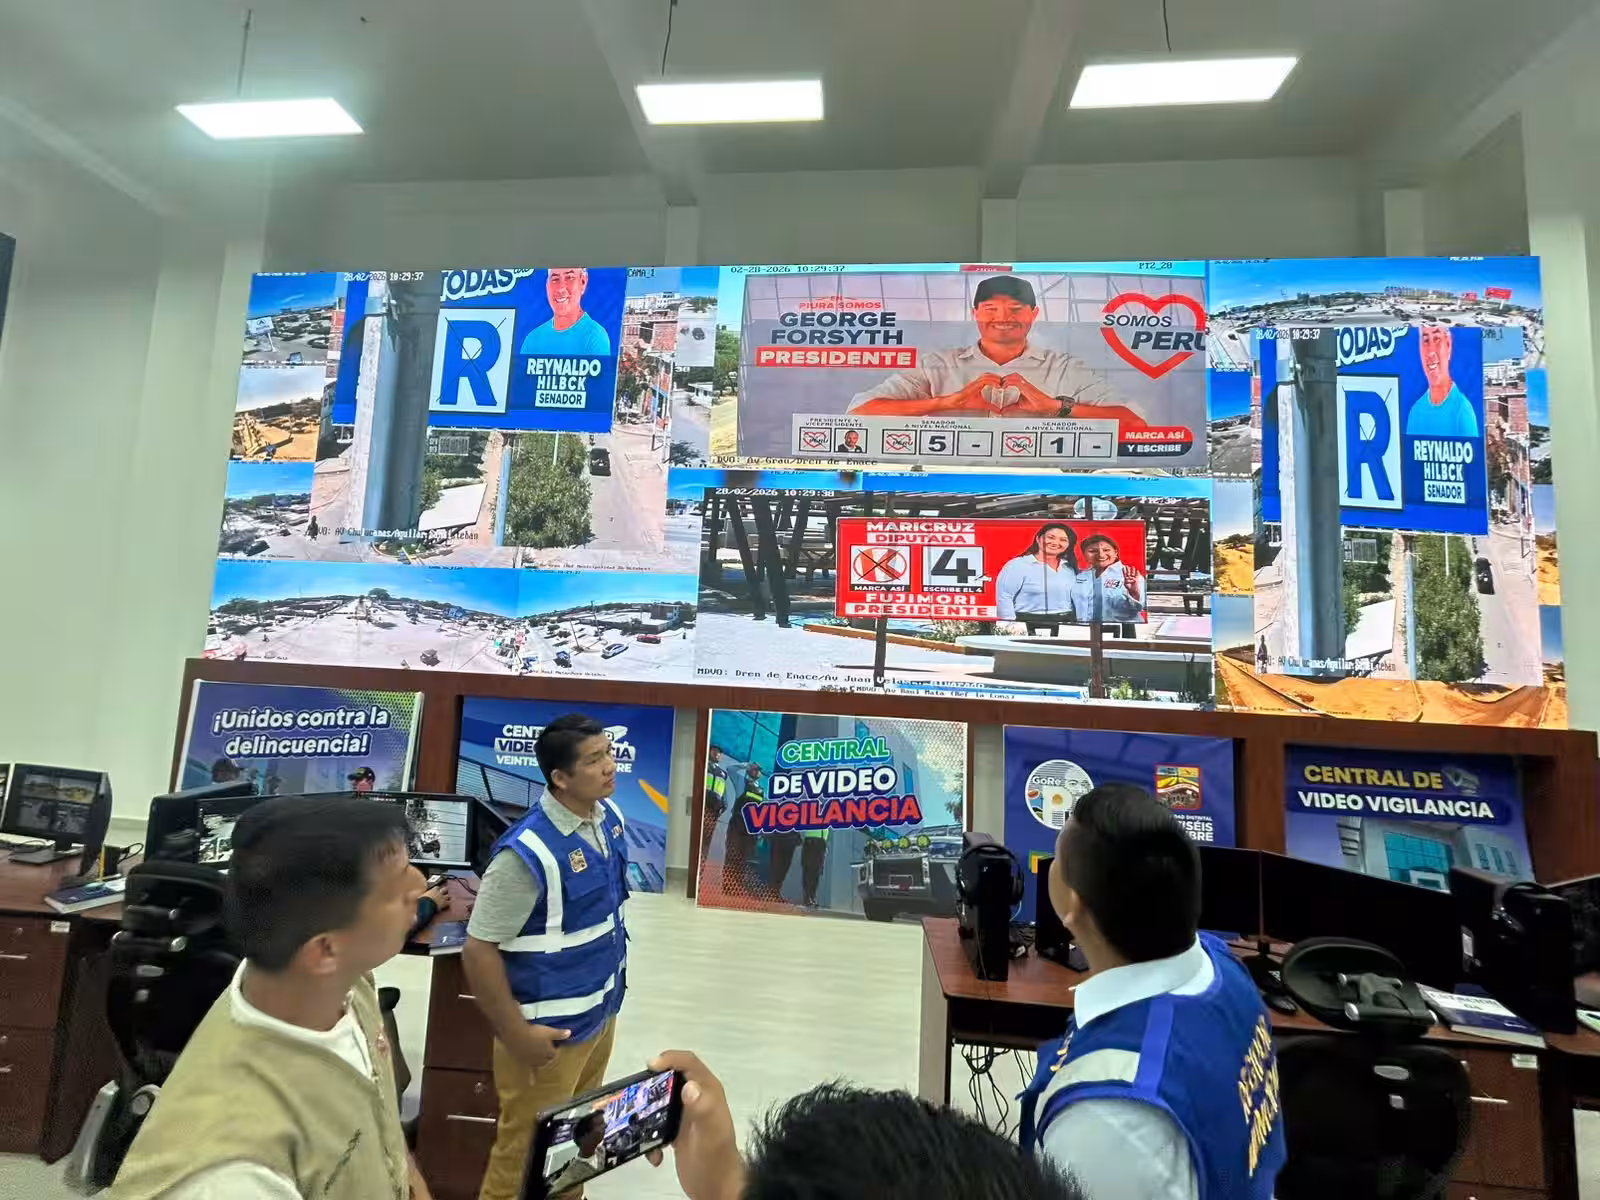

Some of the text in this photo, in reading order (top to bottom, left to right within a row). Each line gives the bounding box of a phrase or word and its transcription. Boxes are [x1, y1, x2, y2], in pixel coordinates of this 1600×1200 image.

[390, 271, 424, 280] 10:29:37
[779, 312, 897, 327] GEORGE
[1102, 314, 1172, 328] SOMOS
[771, 329, 903, 345] FORSYTH
[1292, 329, 1320, 340] 10:29:37
[438, 320, 502, 406] R
[760, 350, 911, 365] PRESIDENTE
[526, 358, 601, 376] REYNALDO
[536, 376, 586, 391] HILBCK
[538, 393, 583, 406] SENADOR
[1167, 430, 1184, 439] ASÍ
[928, 435, 946, 452] 5
[1050, 437, 1064, 454] 1
[1127, 444, 1182, 452] Y ESCRIBE
[1344, 390, 1394, 500] R
[1414, 440, 1473, 463] REYNALDO
[1424, 462, 1464, 481] HILBCK
[715, 488, 778, 496] 28/02/2026
[1427, 484, 1462, 500] SENADOR
[867, 522, 976, 532] MARICRUZ
[875, 534, 967, 543] DIPUTADA
[930, 549, 976, 584] 4
[866, 594, 976, 605] FUJIMORI
[854, 605, 988, 616] PRESIDENTE
[786, 672, 838, 681] Enace/Av
[844, 675, 871, 683] Juan
[213, 706, 389, 732] ¡Unidos contra la
[226, 734, 368, 755] delincuencia!
[498, 740, 534, 752] VIDE
[782, 738, 890, 762] CENTRAL
[773, 768, 896, 795] DE VIDEO
[1304, 765, 1443, 790] CENTRAL DE
[749, 796, 921, 828] VIGILANCIA
[1298, 791, 1494, 818] VIDEO VIGILANCIA
